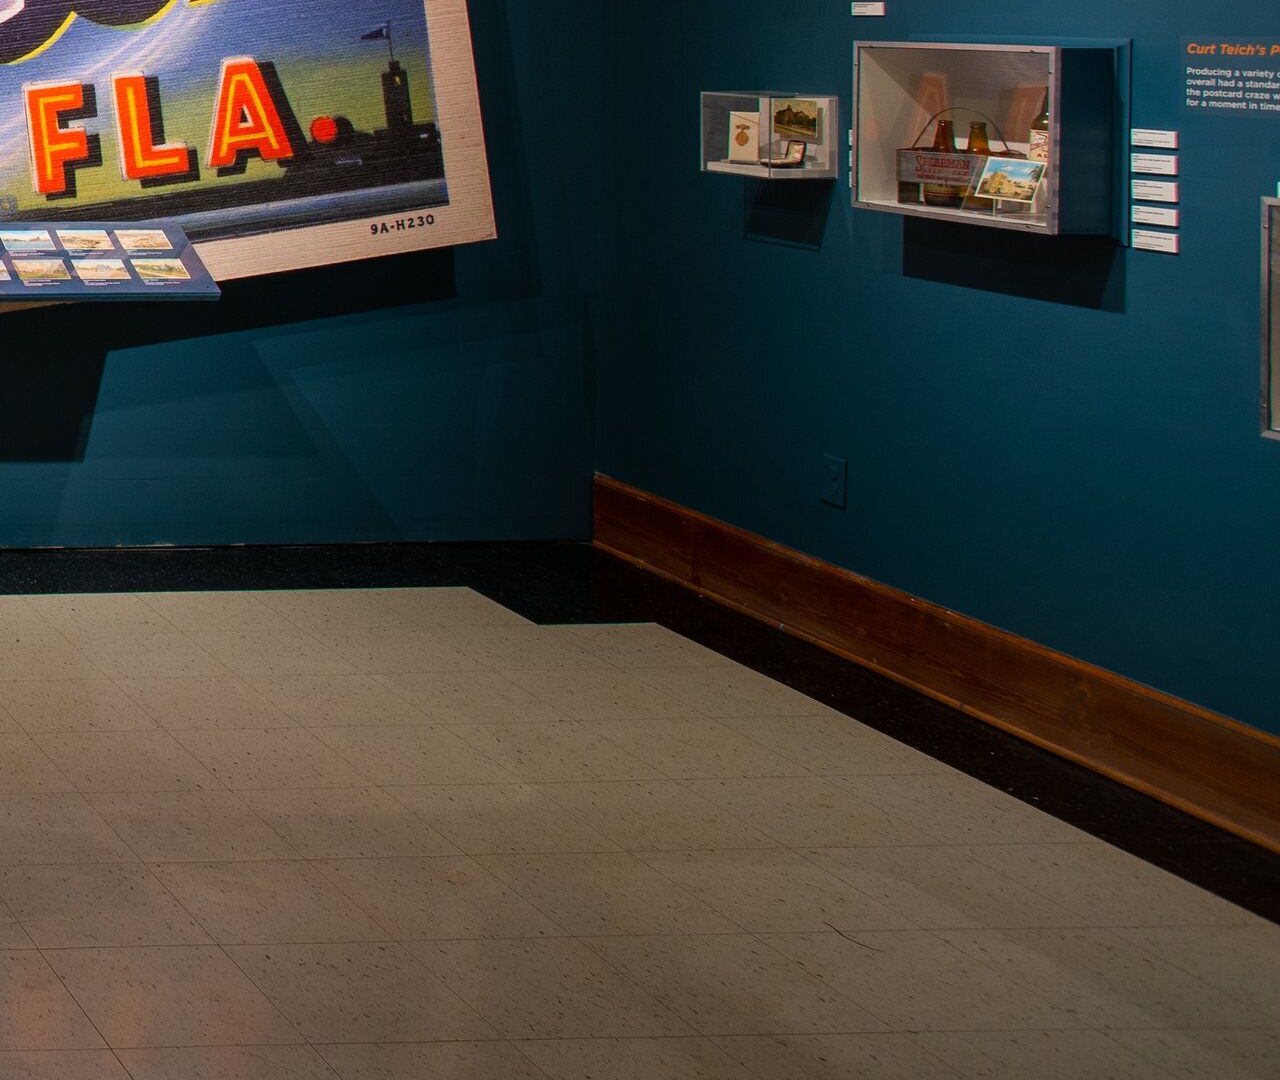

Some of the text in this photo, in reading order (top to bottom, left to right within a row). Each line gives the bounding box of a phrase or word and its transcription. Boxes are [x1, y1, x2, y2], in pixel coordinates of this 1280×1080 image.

[1186, 42, 1217, 55] Curt
[1220, 43, 1267, 56] Teich's
[1185, 66, 1233, 78] Producing
[1233, 69, 1241, 77] a
[1241, 69, 1275, 80] variety
[1185, 78, 1216, 86] overall
[1217, 78, 1235, 87] had
[1236, 80, 1244, 88] a
[1185, 88, 1201, 96] the
[1202, 89, 1243, 98] postcard
[1244, 91, 1271, 100] craze
[1185, 98, 1200, 107] for
[1208, 100, 1247, 110] moment
[1248, 100, 1258, 110] in
[22, 54, 339, 198] FLA.
[915, 155, 971, 172] SPEARMAN
[369, 213, 436, 237] 9A-H230
